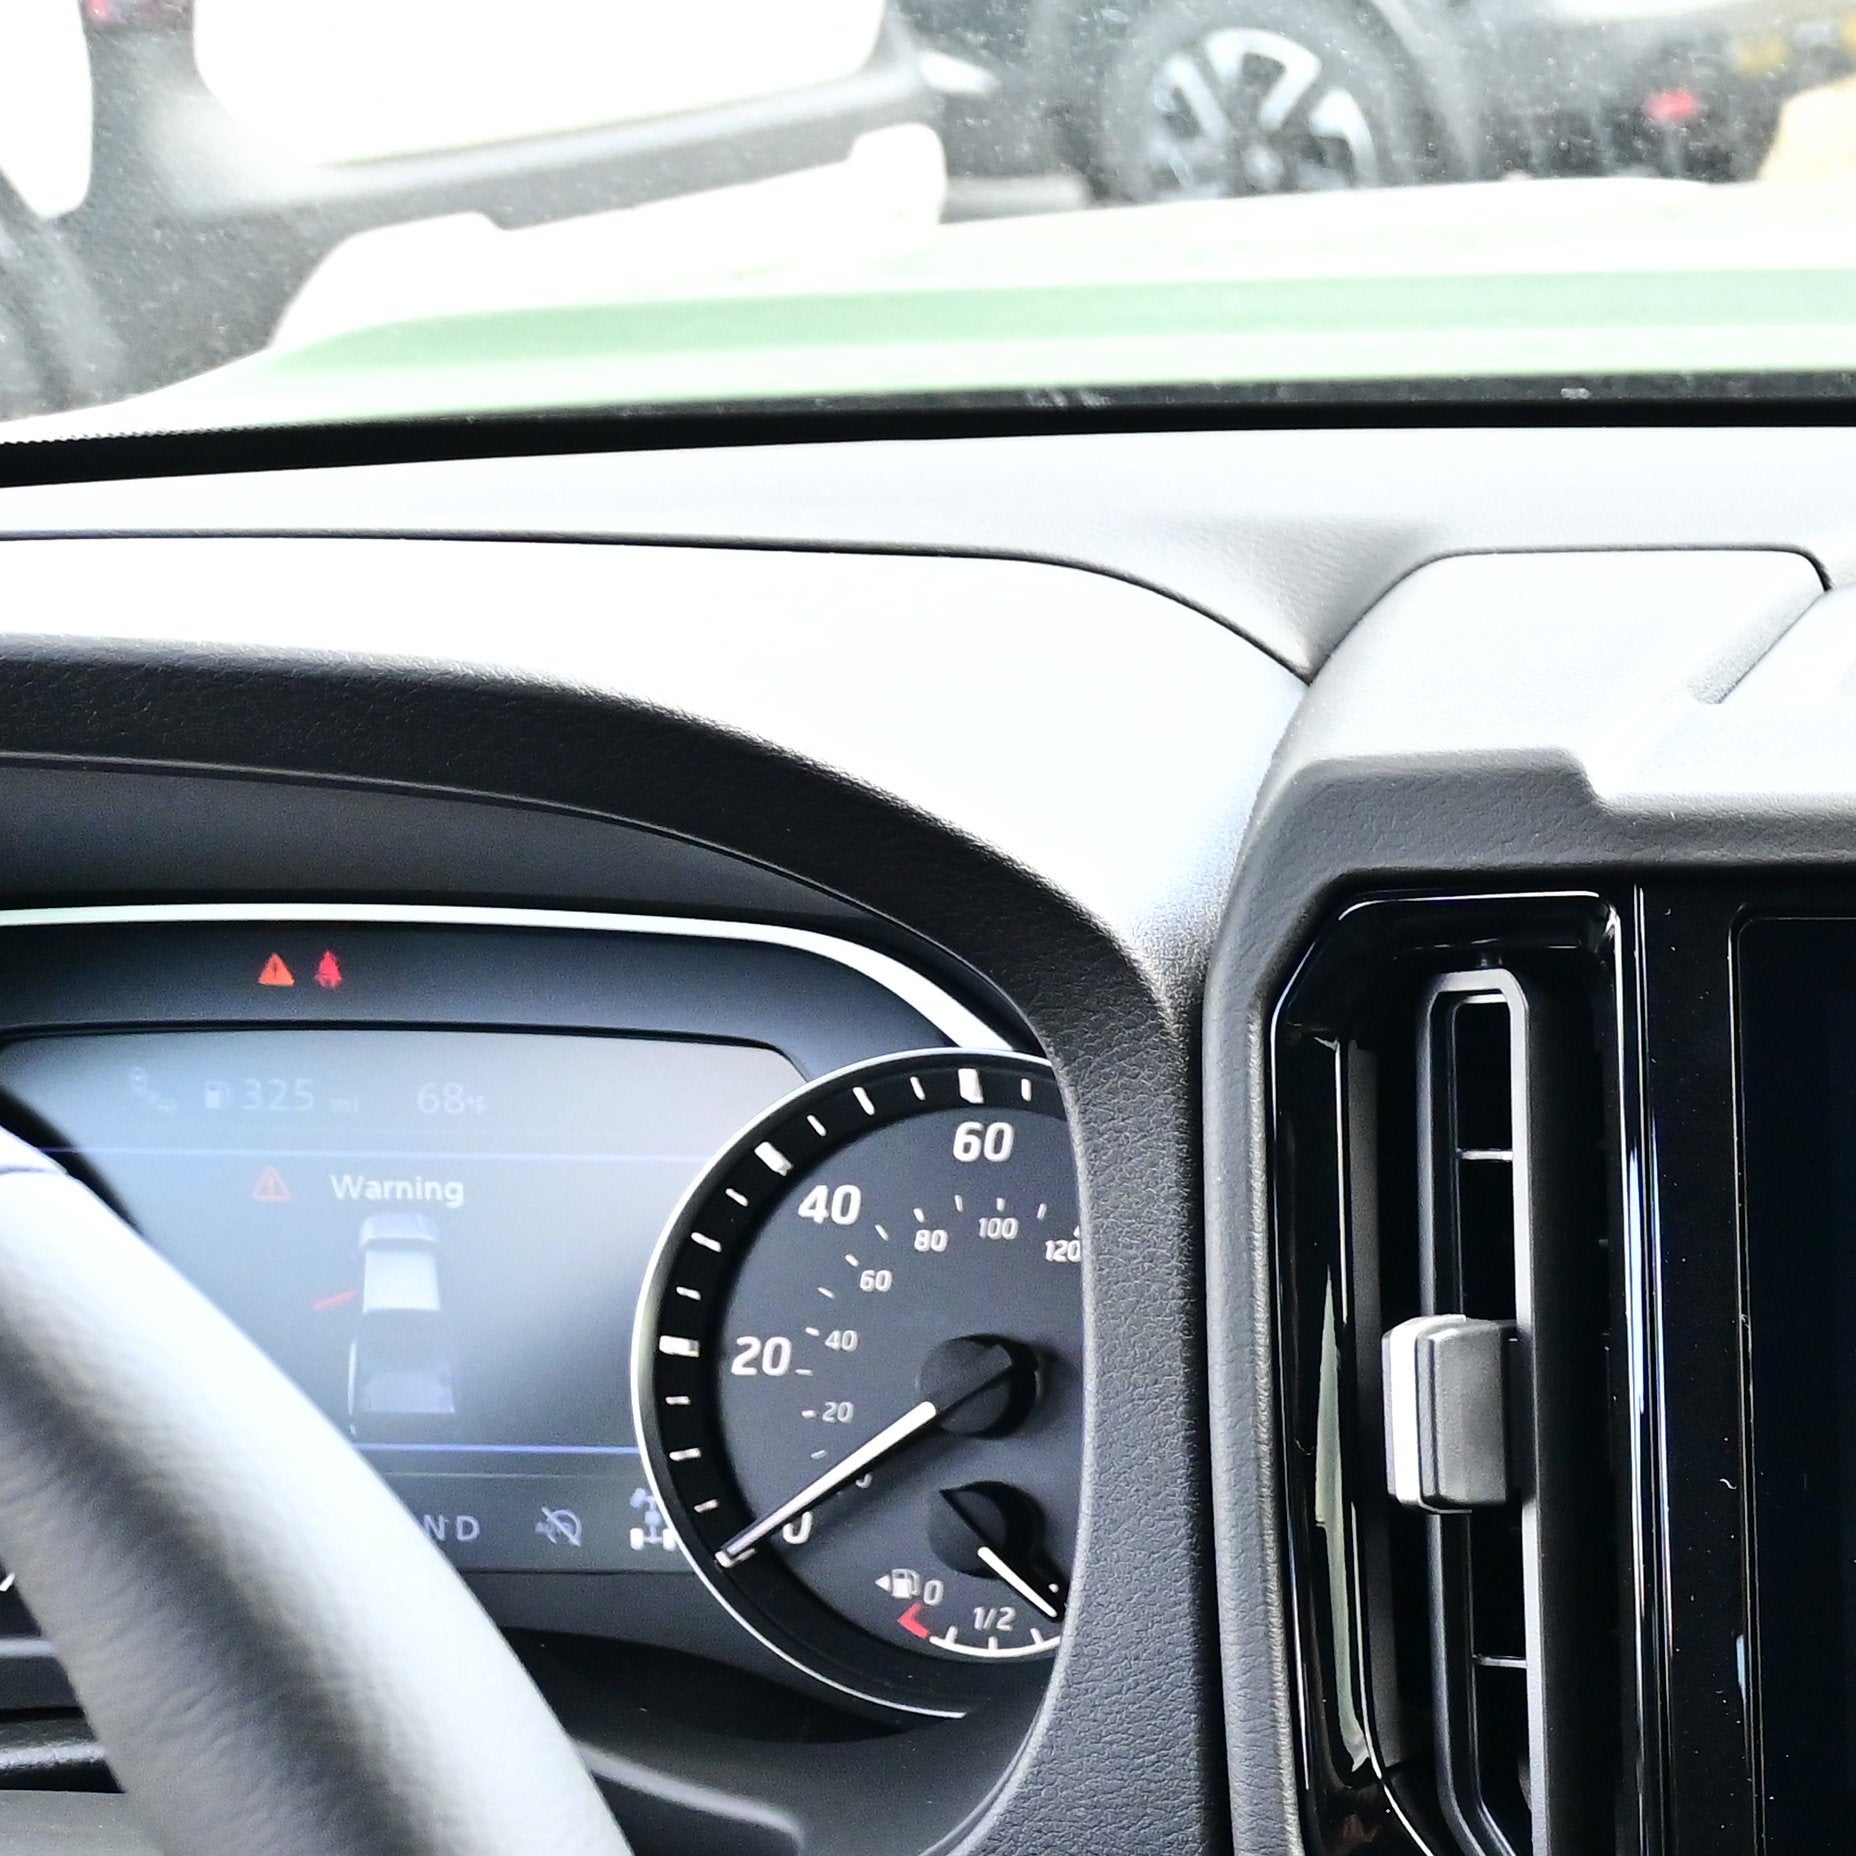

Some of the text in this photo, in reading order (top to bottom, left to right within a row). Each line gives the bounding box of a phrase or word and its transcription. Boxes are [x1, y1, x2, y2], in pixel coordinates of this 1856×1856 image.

[952, 1121, 1014, 1162] 60
[330, 1174, 464, 1208] Warning
[797, 1184, 861, 1225] 40
[913, 1229, 948, 1252] 80
[978, 1217, 1019, 1240] 100
[859, 1269, 893, 1292] 60
[824, 1329, 858, 1351] 40
[730, 1335, 792, 1377] 20
[822, 1401, 854, 1423] 20
[923, 1579, 944, 1606] 0
[973, 1606, 1016, 1631] 1/2
